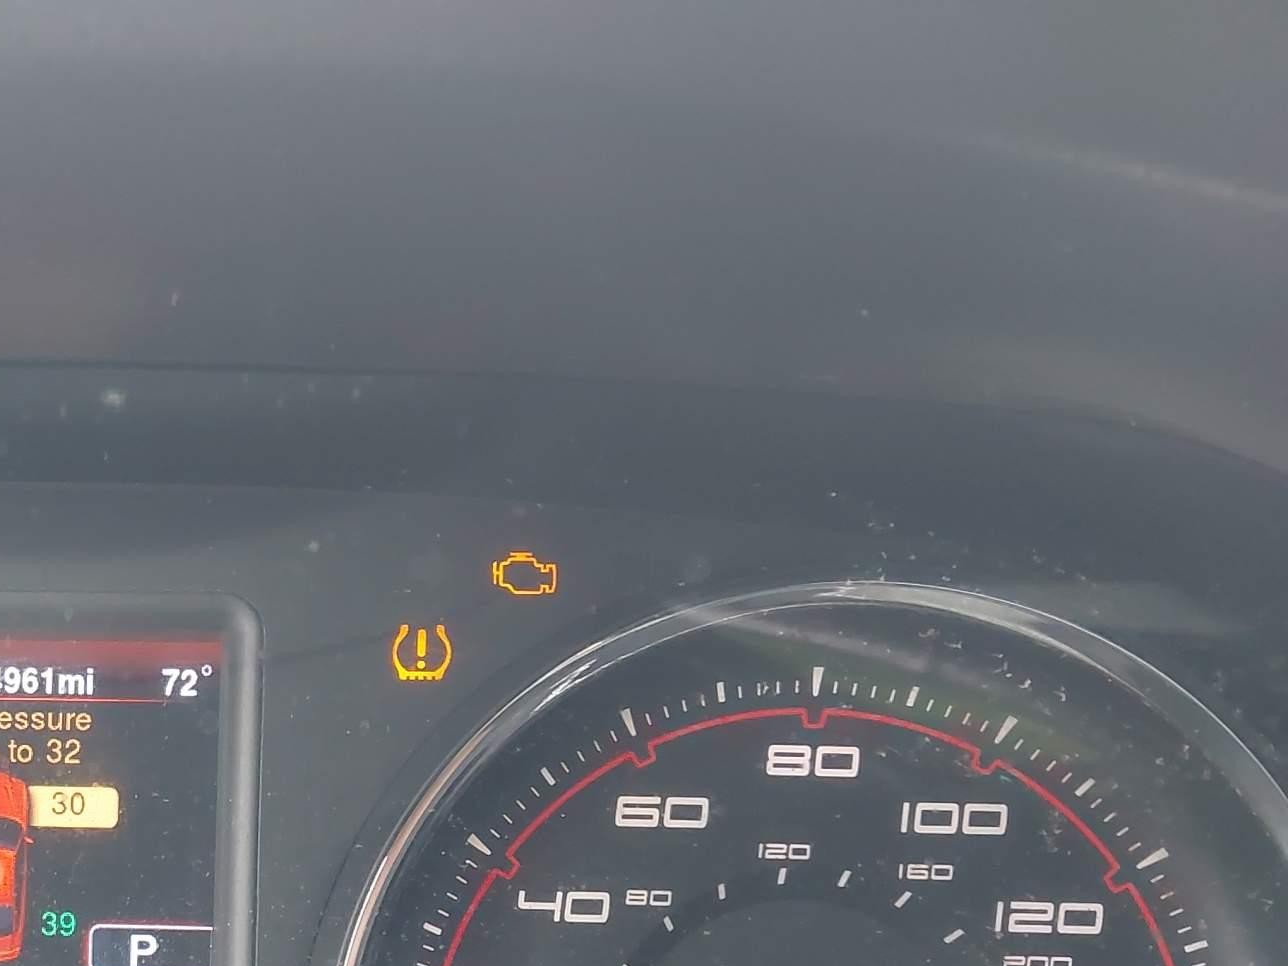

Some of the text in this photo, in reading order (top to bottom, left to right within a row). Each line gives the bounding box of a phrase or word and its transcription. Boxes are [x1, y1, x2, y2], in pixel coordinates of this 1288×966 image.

[162, 664, 212, 696] 72°
[9, 739, 33, 763] to
[46, 740, 81, 764] 32
[766, 745, 860, 779] 80
[51, 792, 86, 816] 30
[615, 796, 710, 828] 60
[900, 802, 1007, 835] 100
[758, 843, 811, 862] 120
[898, 864, 954, 881] 160
[517, 890, 611, 924] 40
[625, 889, 672, 907] 80
[42, 912, 76, 936] 39
[995, 901, 1104, 935] 120
